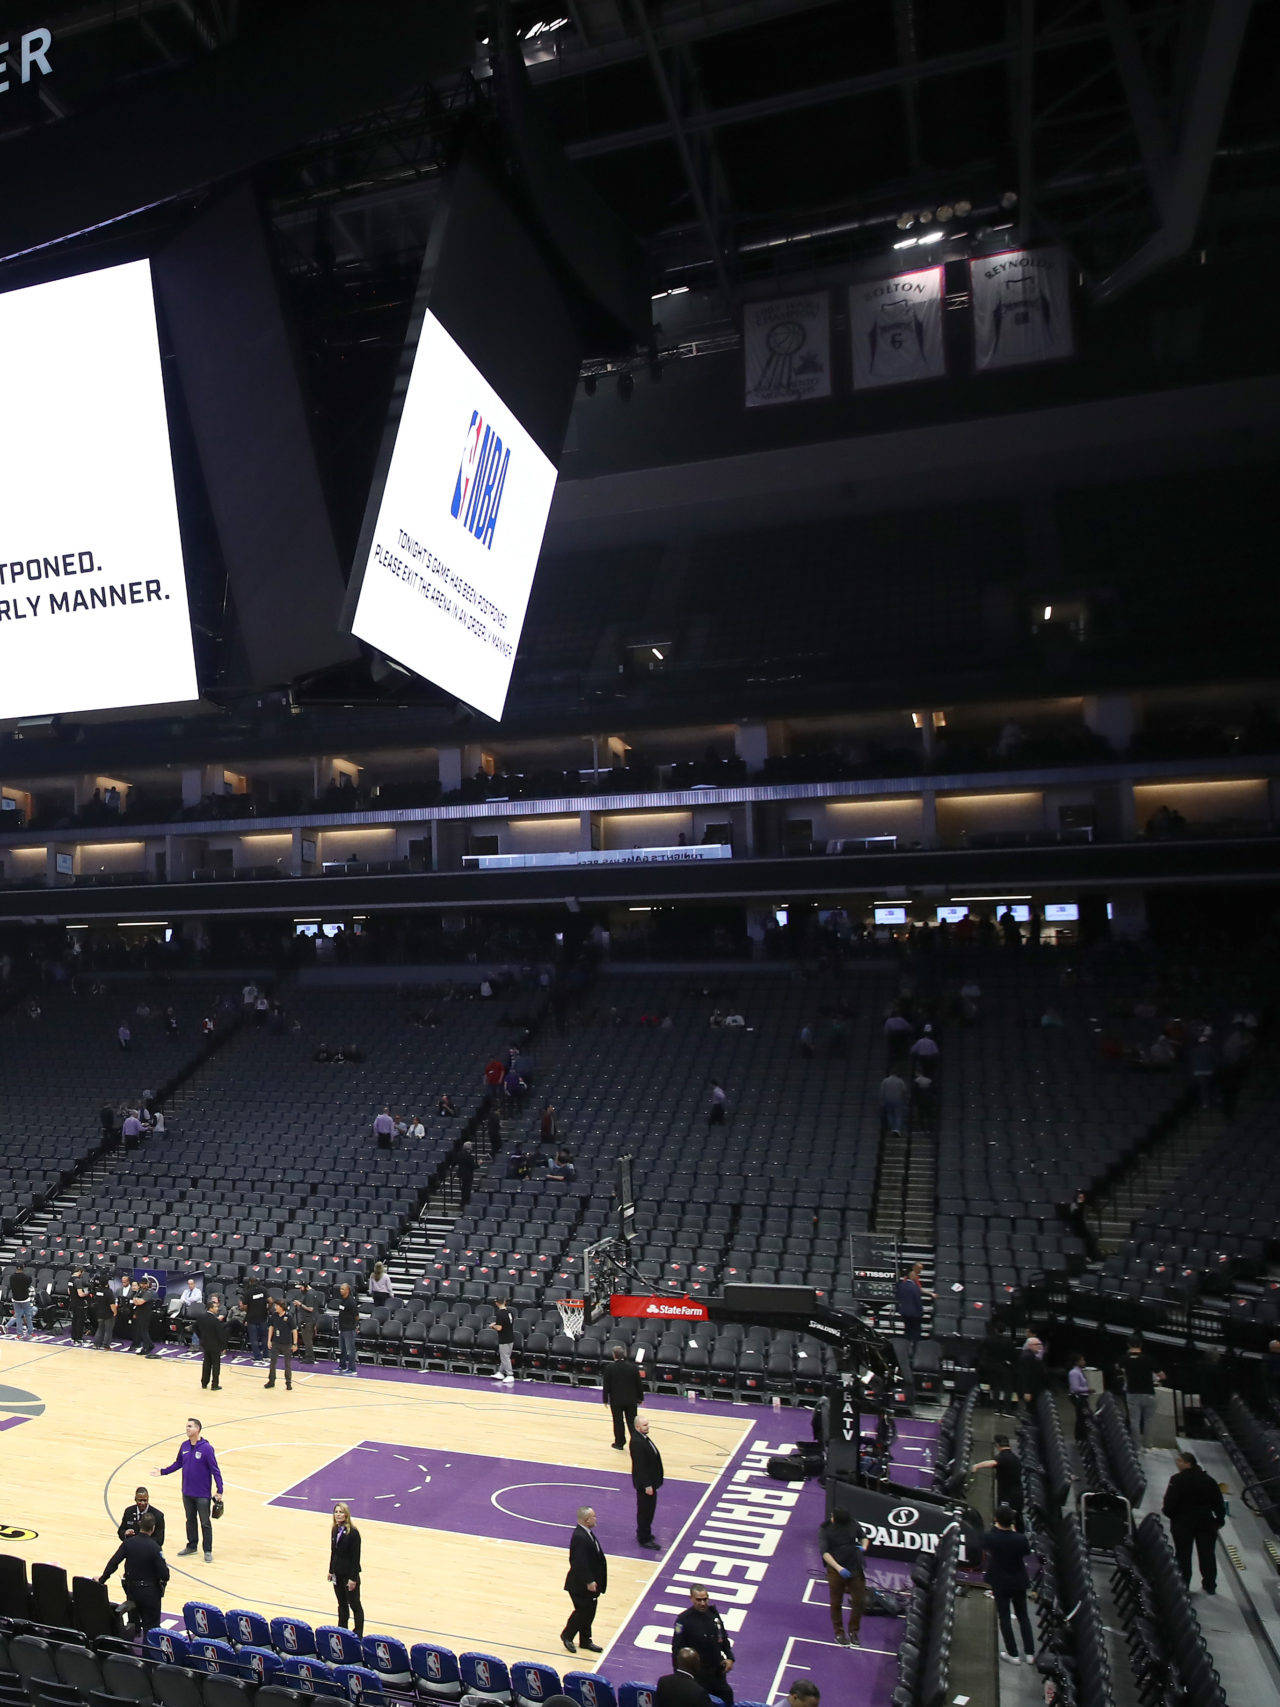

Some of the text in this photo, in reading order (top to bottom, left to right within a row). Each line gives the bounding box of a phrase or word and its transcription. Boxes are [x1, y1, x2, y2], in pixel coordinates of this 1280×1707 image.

[866, 282, 926, 297] OLTON
[463, 423, 511, 551] NBA
[374, 543, 402, 577] PLEASE
[402, 565, 418, 588] EXIT
[419, 576, 431, 598] THE
[431, 557, 450, 583] GAME
[49, 579, 169, 614] MANNER.
[866, 1271, 896, 1279] TISSOT
